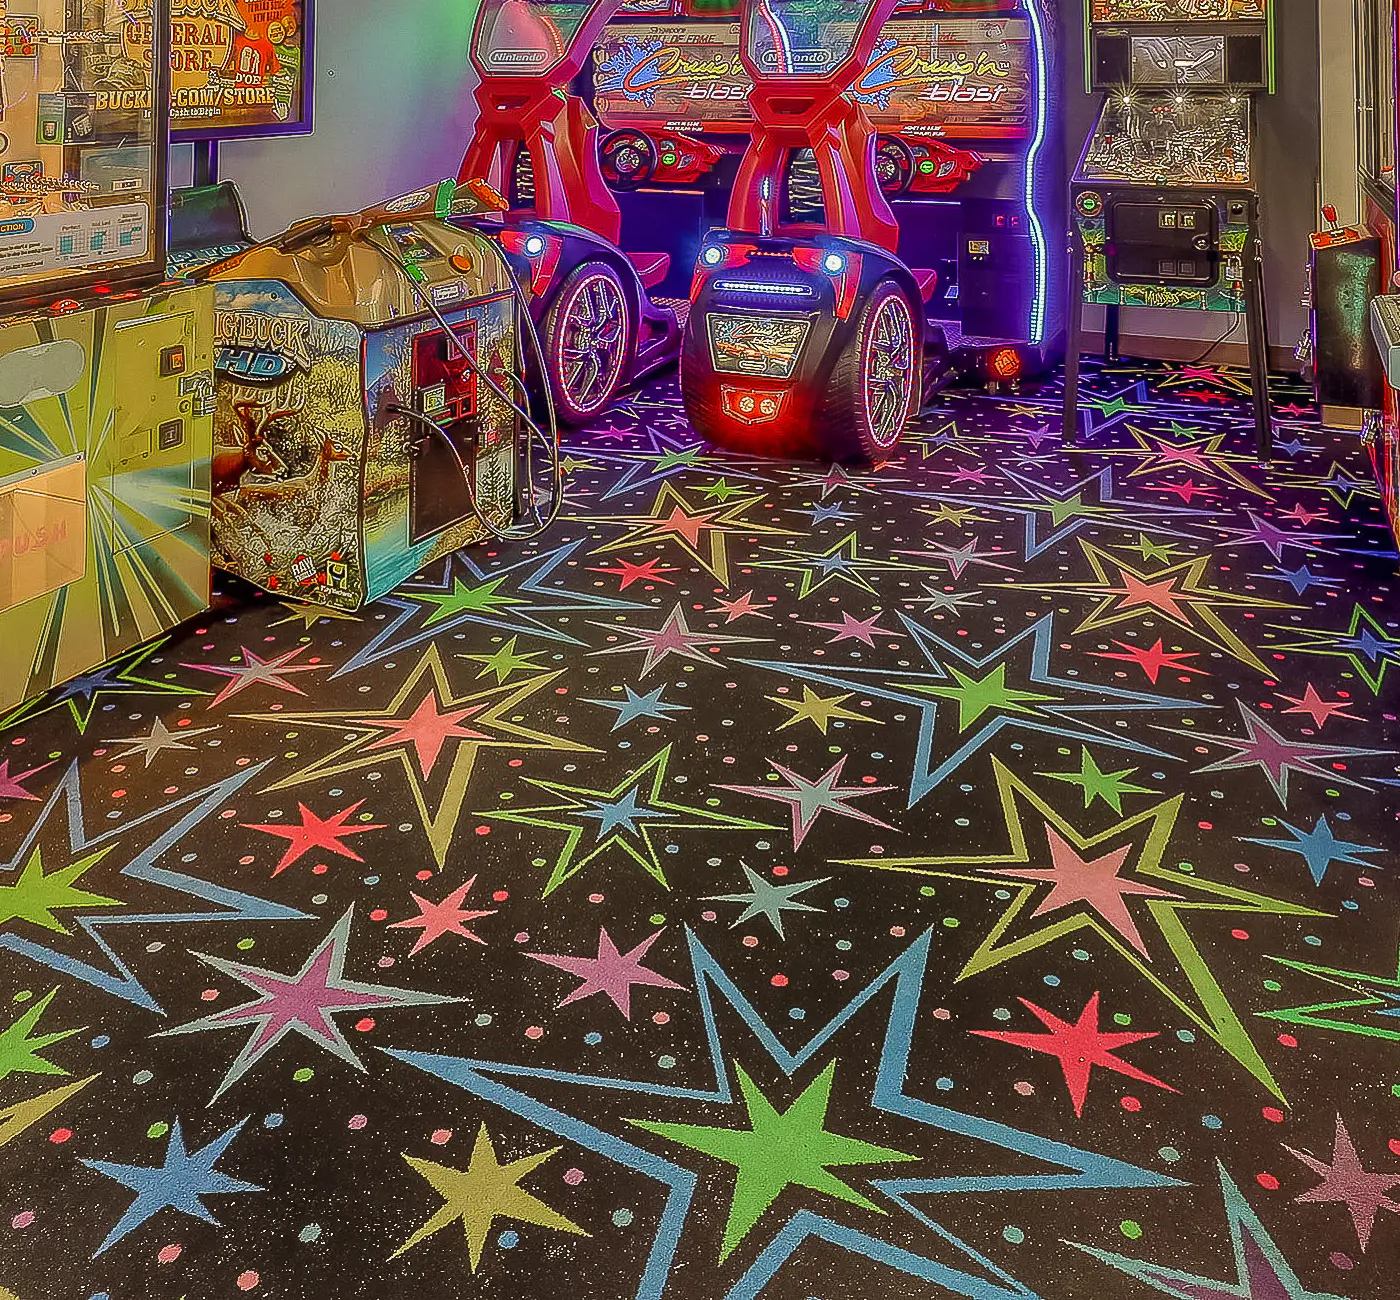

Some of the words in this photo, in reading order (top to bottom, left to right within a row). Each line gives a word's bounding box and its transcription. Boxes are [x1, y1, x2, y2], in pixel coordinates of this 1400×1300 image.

[126, 21, 227, 46] GEERAL
[142, 49, 213, 72] SORE
[492, 52, 542, 62] Nintendo
[767, 51, 826, 63] Nendo
[922, 84, 1007, 102] blast
[213, 310, 236, 340] IG
[239, 314, 311, 370] BUCK
[214, 348, 286, 376] HD
[291, 556, 314, 576] RAW
